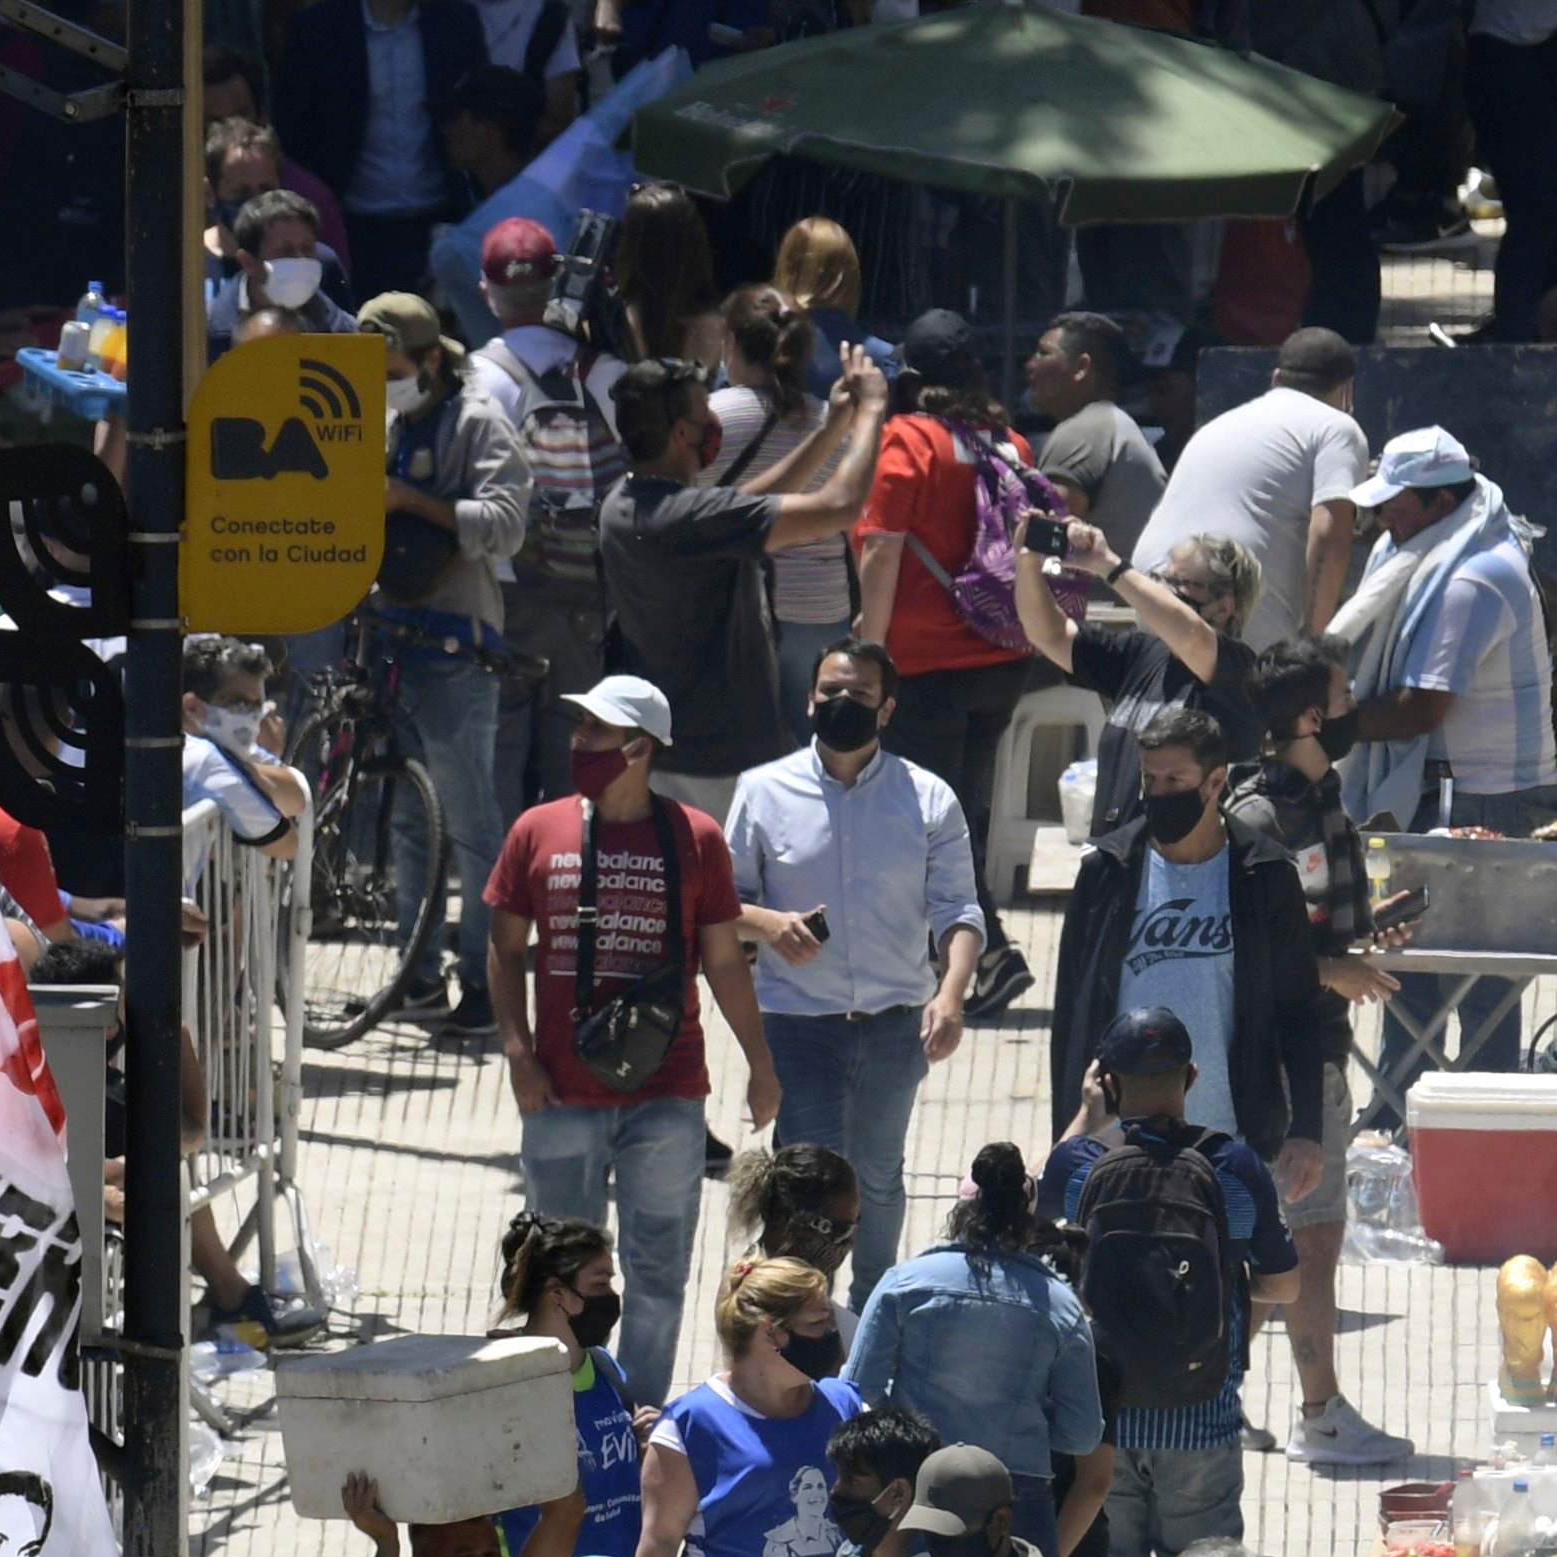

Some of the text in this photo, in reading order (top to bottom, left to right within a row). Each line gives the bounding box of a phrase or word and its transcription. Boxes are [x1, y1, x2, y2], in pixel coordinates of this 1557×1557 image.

[316, 426, 362, 443] WiFi
[211, 518, 335, 535] Conectate
[211, 544, 366, 563] con la Ciudad
[597, 851, 665, 872] balanc
[598, 912, 667, 933] alance
[596, 933, 662, 954] alance
